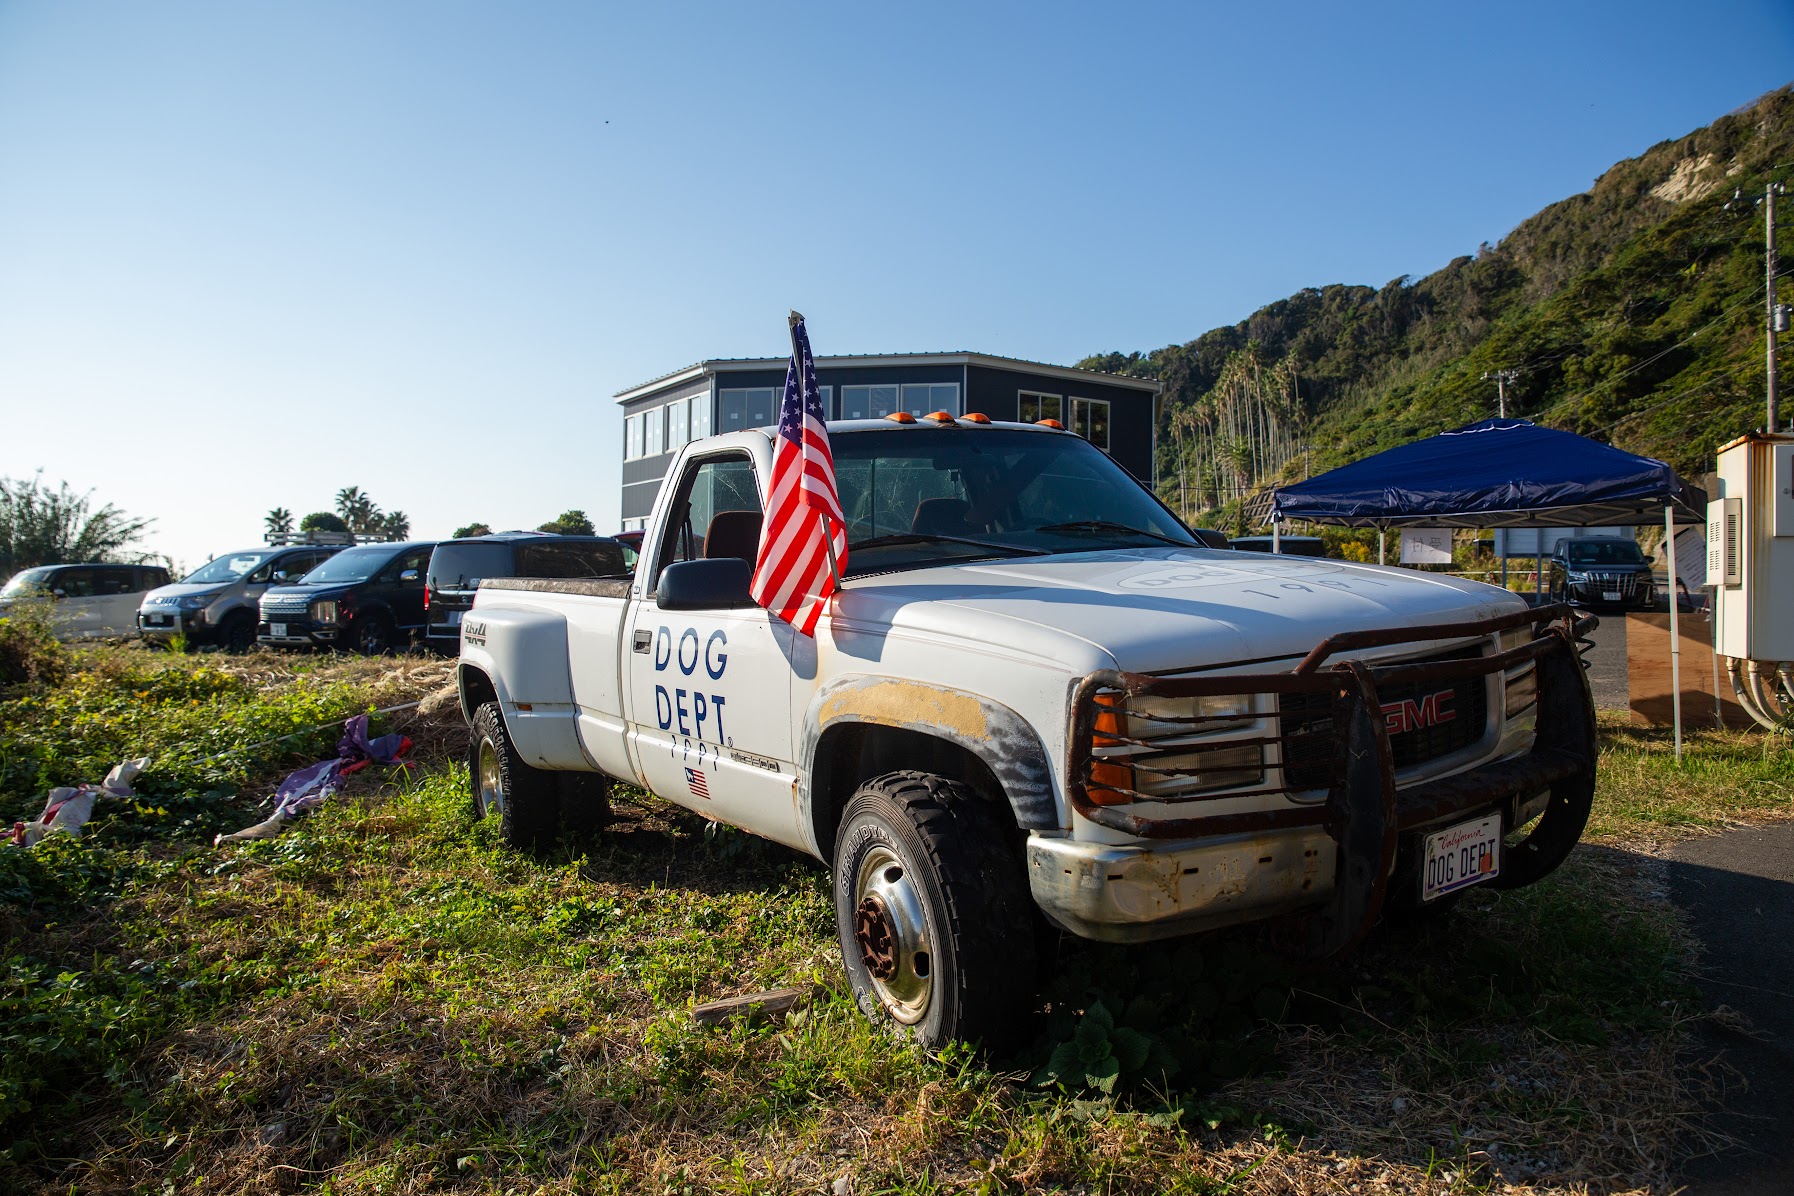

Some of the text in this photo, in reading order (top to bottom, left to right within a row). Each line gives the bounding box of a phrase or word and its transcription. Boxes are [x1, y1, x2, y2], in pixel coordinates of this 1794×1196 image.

[1241, 578, 1389, 599] 1991
[655, 625, 728, 680] DOG
[655, 685, 726, 745] DEPT
[1380, 689, 1457, 735] GMC
[1441, 826, 1485, 850] California
[1427, 838, 1495, 889] DOG DEPT
